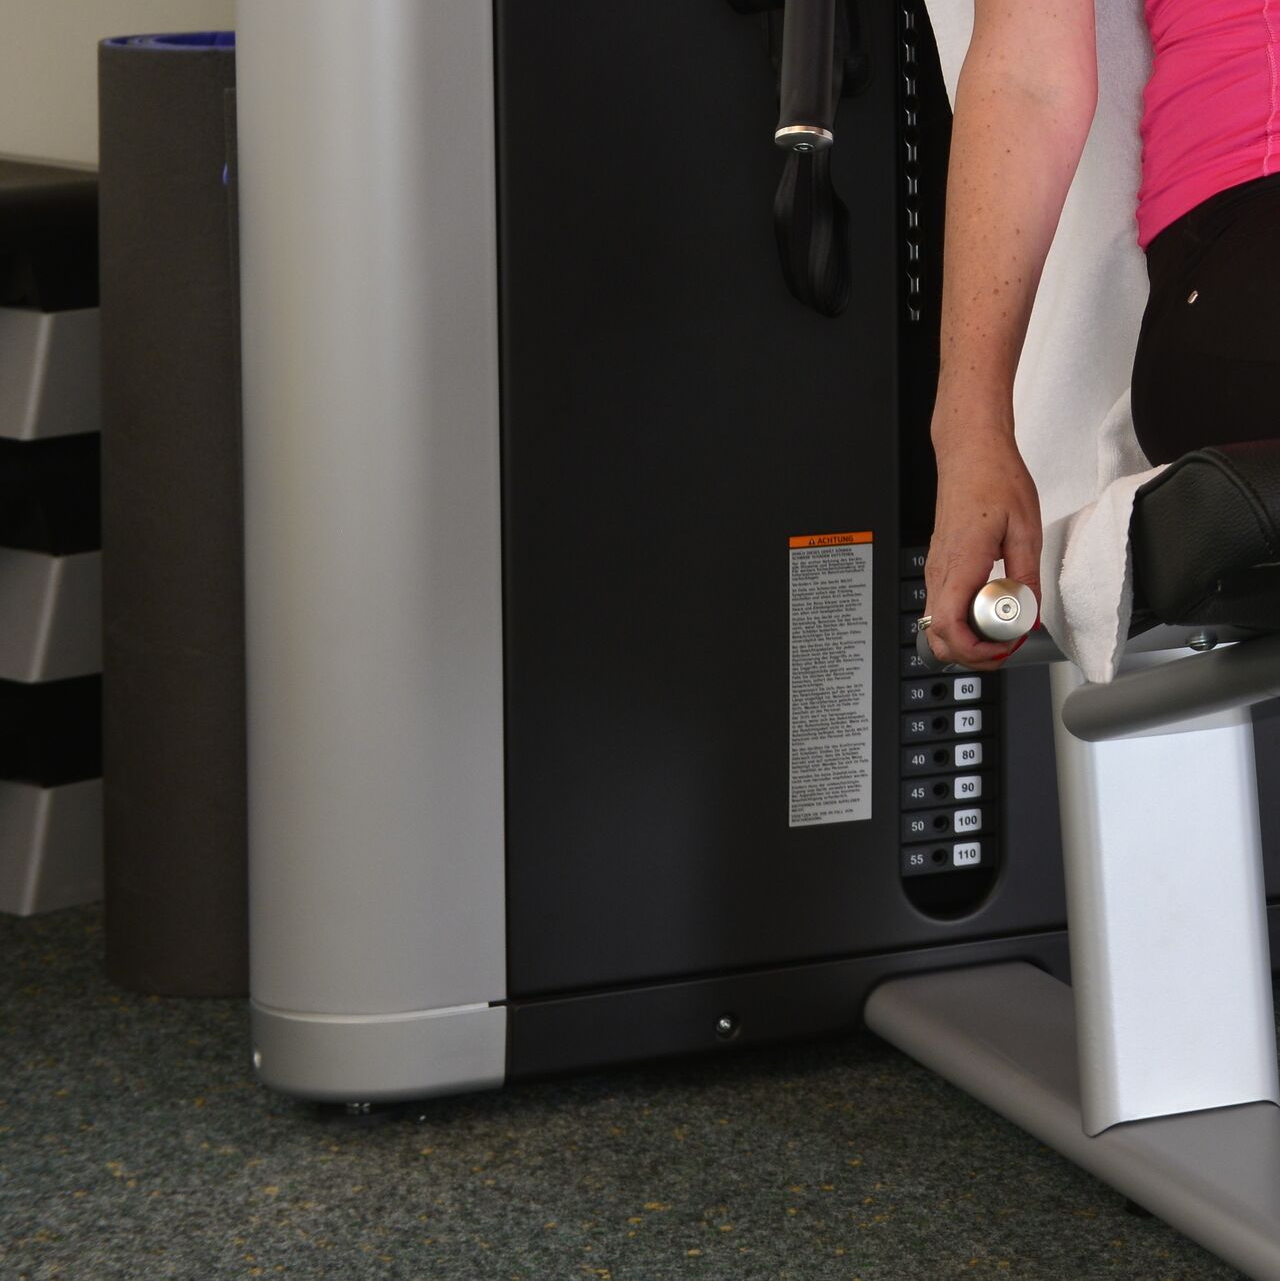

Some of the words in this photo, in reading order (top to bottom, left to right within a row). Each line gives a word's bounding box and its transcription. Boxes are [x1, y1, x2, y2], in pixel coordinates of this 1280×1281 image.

[817, 535, 854, 545] ACHTUNG
[912, 556, 925, 567] 10
[913, 589, 926, 599] 15
[911, 688, 924, 699] 30
[961, 684, 974, 694] 60
[911, 721, 925, 732] 35
[961, 716, 975, 727] 70
[911, 754, 925, 765] 40
[962, 749, 975, 760] 80
[911, 787, 925, 798] 45
[961, 782, 974, 793] 90
[911, 820, 925, 831] 50
[958, 815, 977, 826] 100
[958, 848, 977, 859] 110
[910, 854, 924, 865] 55
